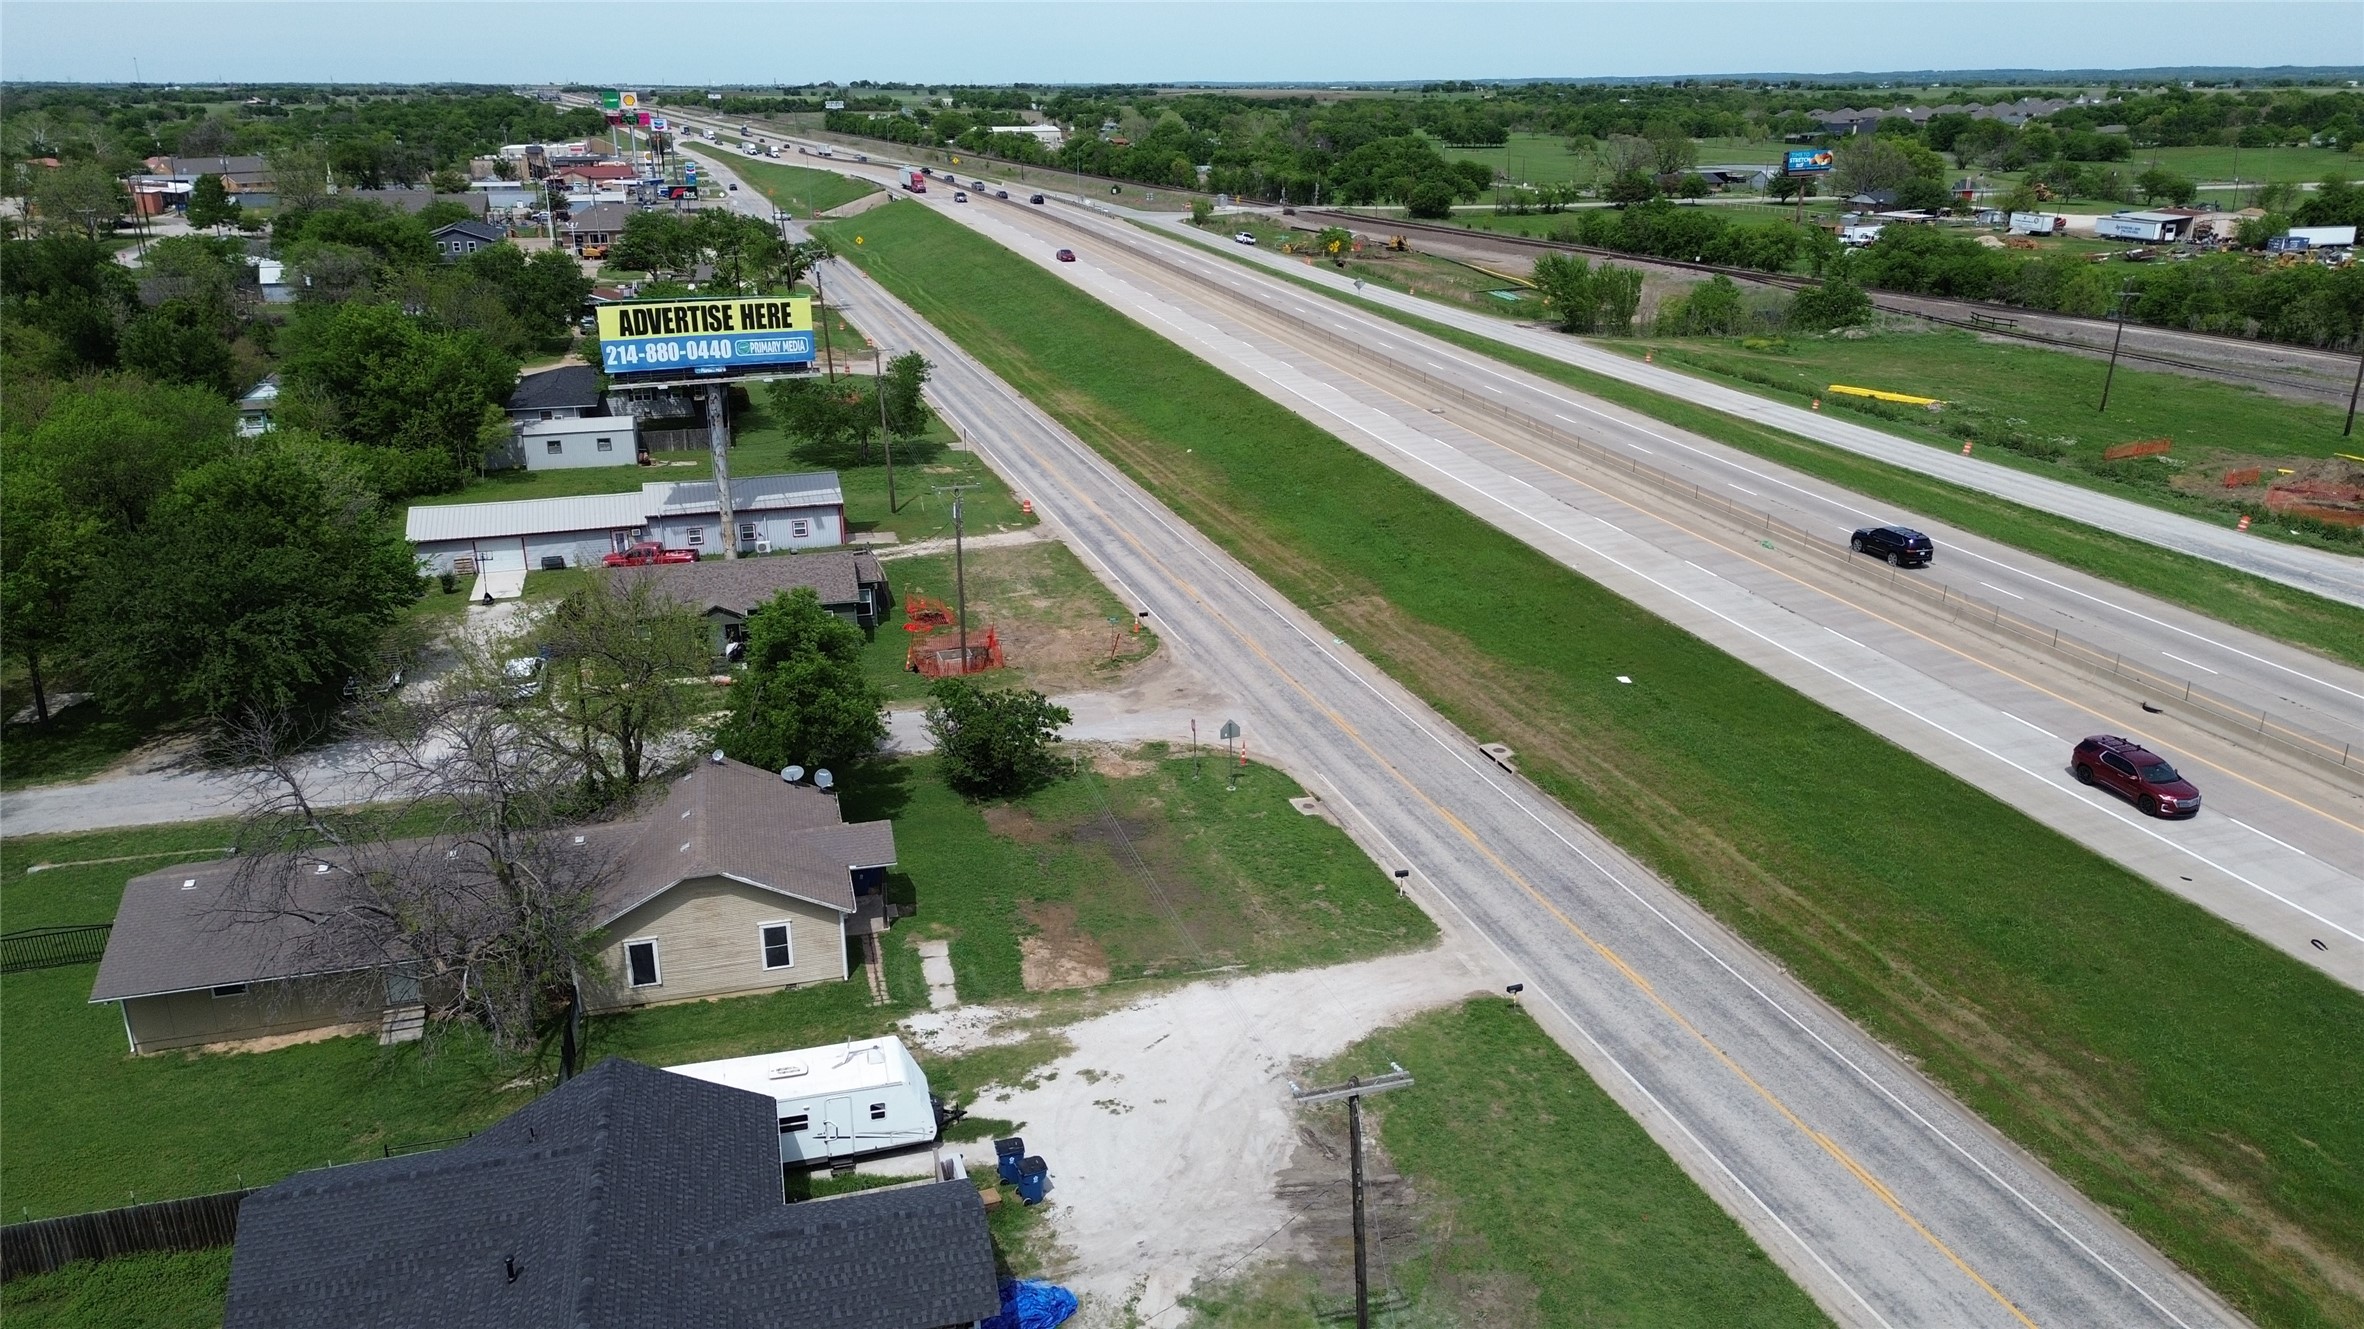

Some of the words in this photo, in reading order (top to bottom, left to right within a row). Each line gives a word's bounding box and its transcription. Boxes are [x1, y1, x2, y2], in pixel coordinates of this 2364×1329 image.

[619, 304, 735, 337] ADVERTISE
[740, 302, 793, 330] HERE
[605, 339, 732, 365] 214-880-0440
[749, 341, 781, 353] PRIMARY
[782, 340, 806, 352] MEDIA
